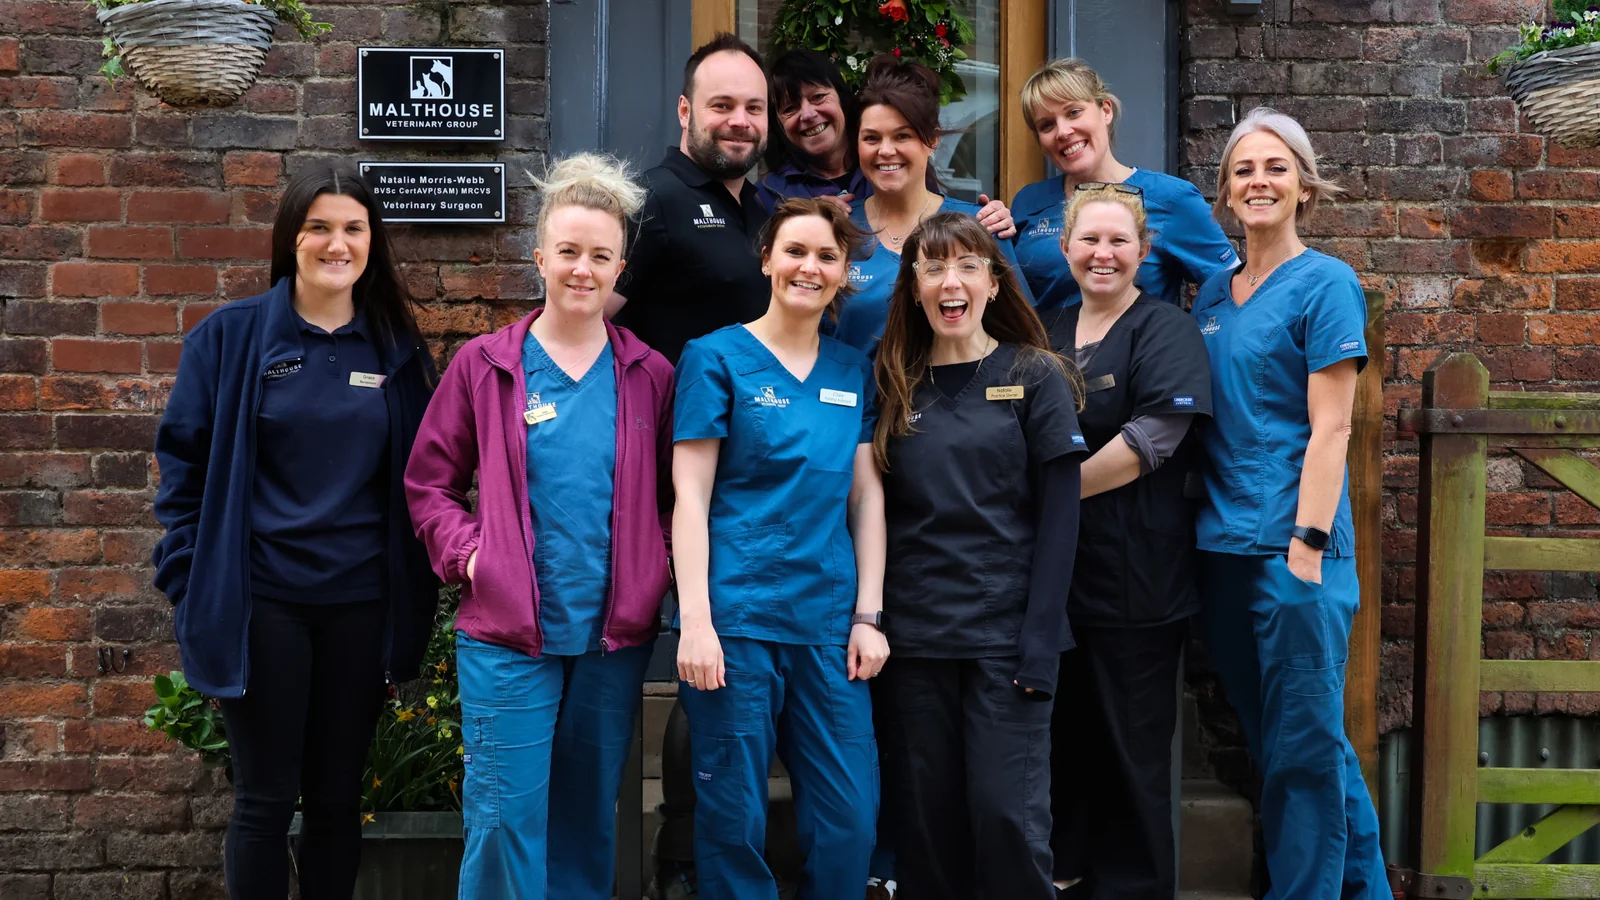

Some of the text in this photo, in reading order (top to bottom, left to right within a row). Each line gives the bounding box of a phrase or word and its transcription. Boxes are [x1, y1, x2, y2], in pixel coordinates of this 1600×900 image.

[369, 103, 494, 118] MALTHOUSE
[386, 120, 478, 129] VETERINARY GROUP
[380, 176, 485, 184] Natalie Morris-Webb
[399, 187, 459, 196] CertAVP(SAM)
[383, 201, 483, 211] Veterinary Surgeon
[693, 217, 726, 225] MALTHOUSE
